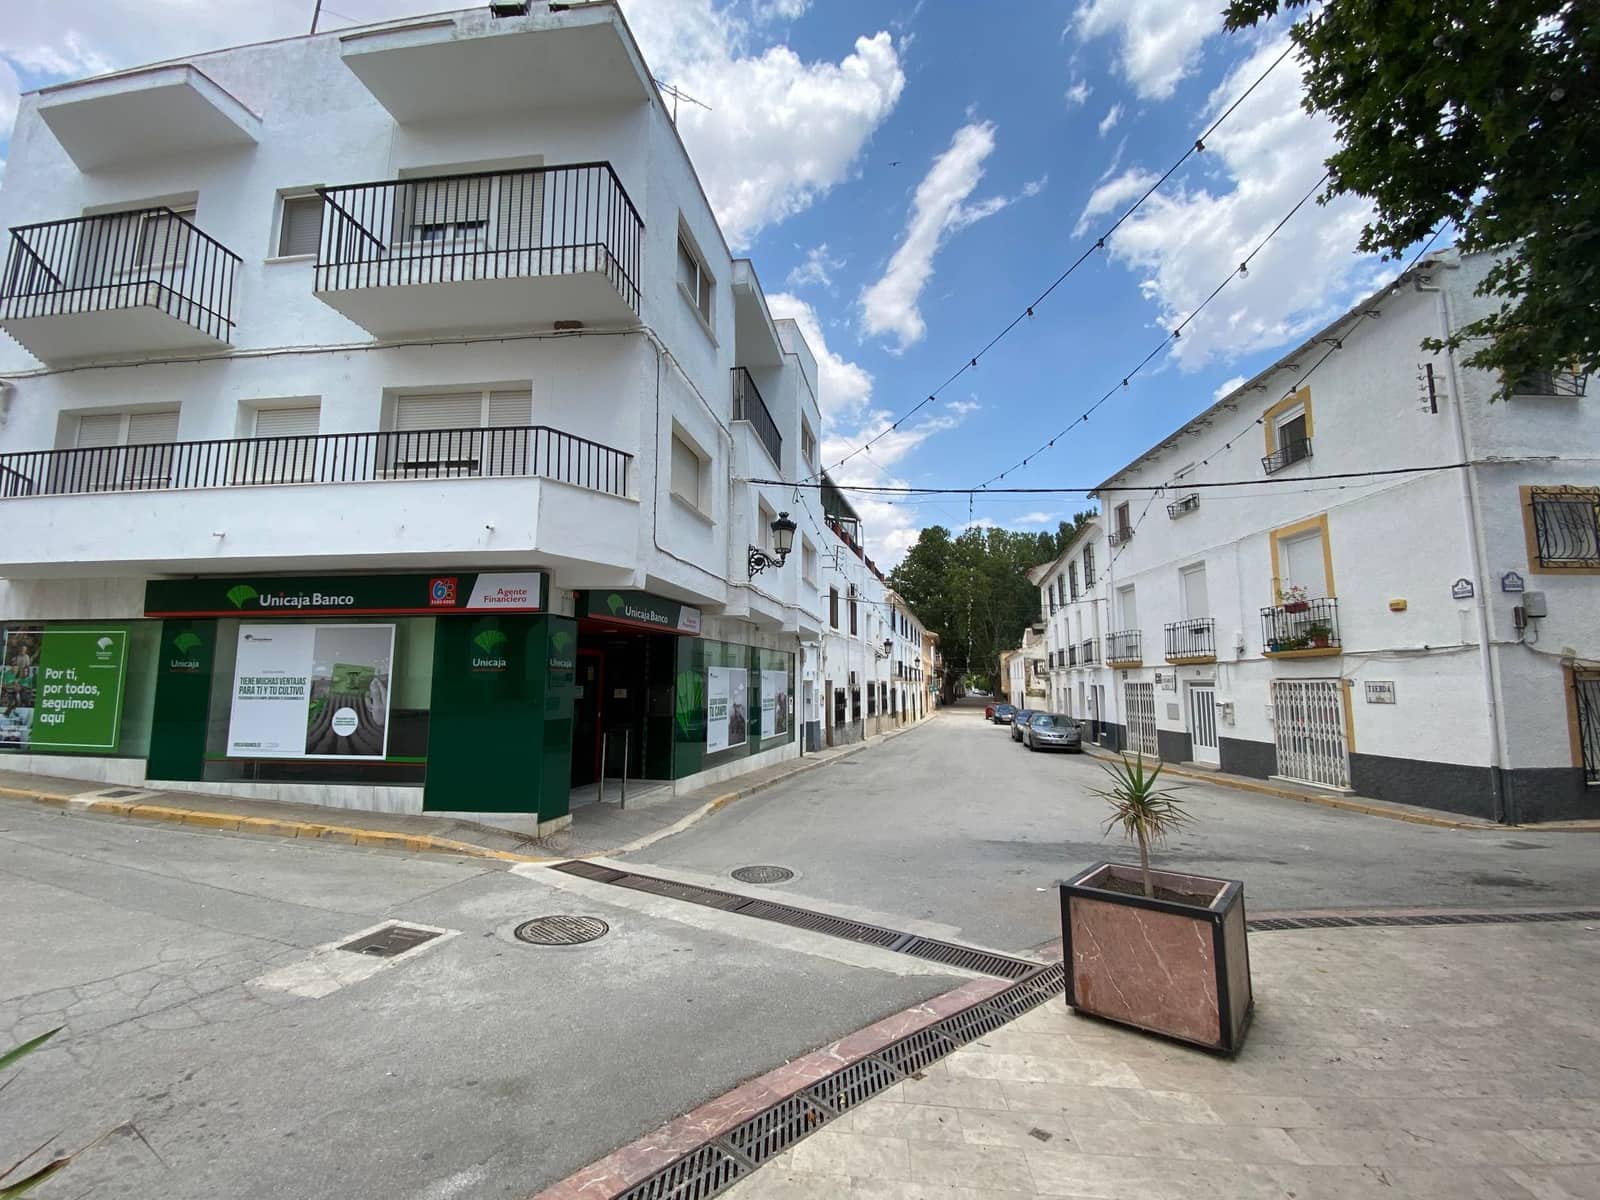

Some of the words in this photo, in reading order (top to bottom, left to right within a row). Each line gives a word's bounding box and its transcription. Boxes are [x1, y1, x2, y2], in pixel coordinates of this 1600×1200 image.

[497, 587, 527, 597] Agente
[259, 592, 311, 608] Unicaja
[312, 593, 354, 605] Banco
[483, 595, 527, 604] Financiero
[625, 605, 650, 621] Unicaja
[650, 611, 668, 624] Banco
[171, 659, 200, 669] Unicaja
[472, 658, 507, 668] Unicaja
[46, 668, 63, 679] Por
[43, 685, 63, 697] por
[65, 682, 101, 697] todos,
[239, 686, 255, 695] PARA
[270, 686, 278, 695] TU
[42, 697, 94, 711] seguimos
